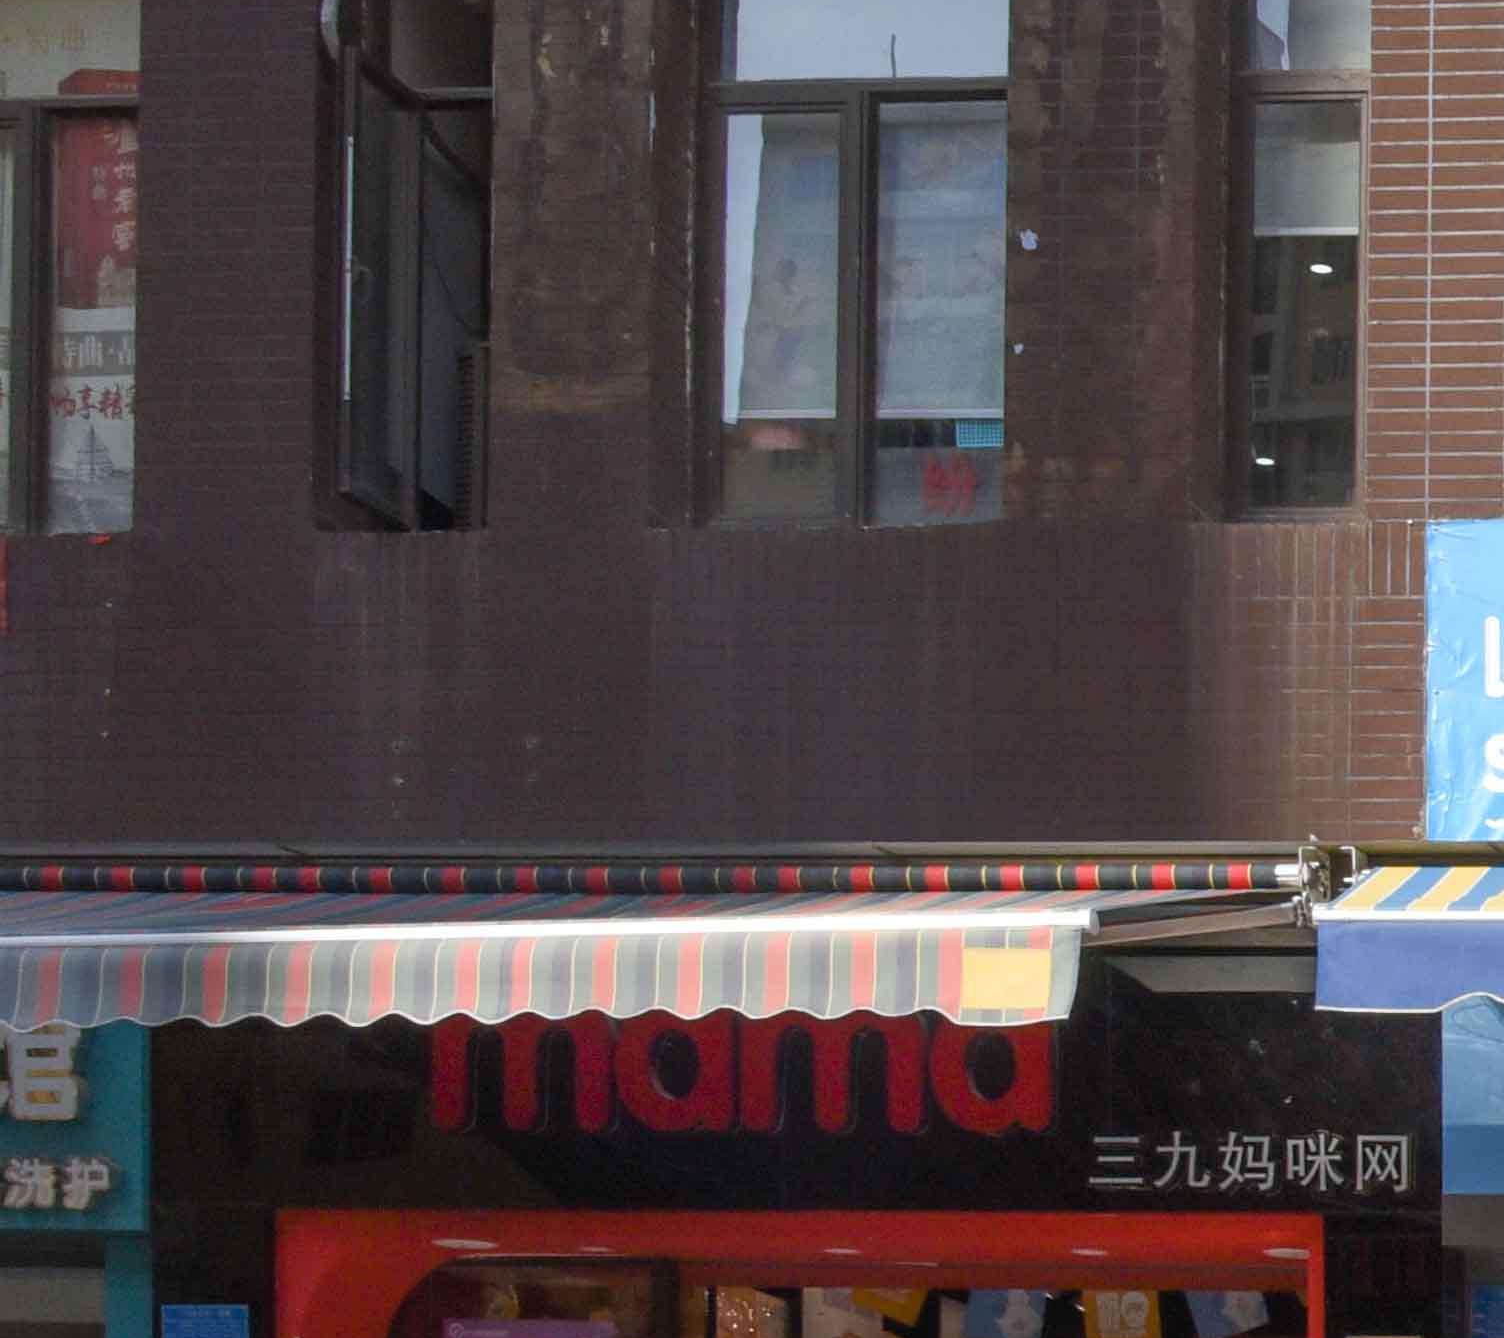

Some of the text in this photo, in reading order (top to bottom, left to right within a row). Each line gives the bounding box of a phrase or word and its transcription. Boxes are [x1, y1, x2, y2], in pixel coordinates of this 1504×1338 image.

[429, 1014, 1050, 1133] mama
[1089, 1133, 1411, 1194] 三九妈咪网
